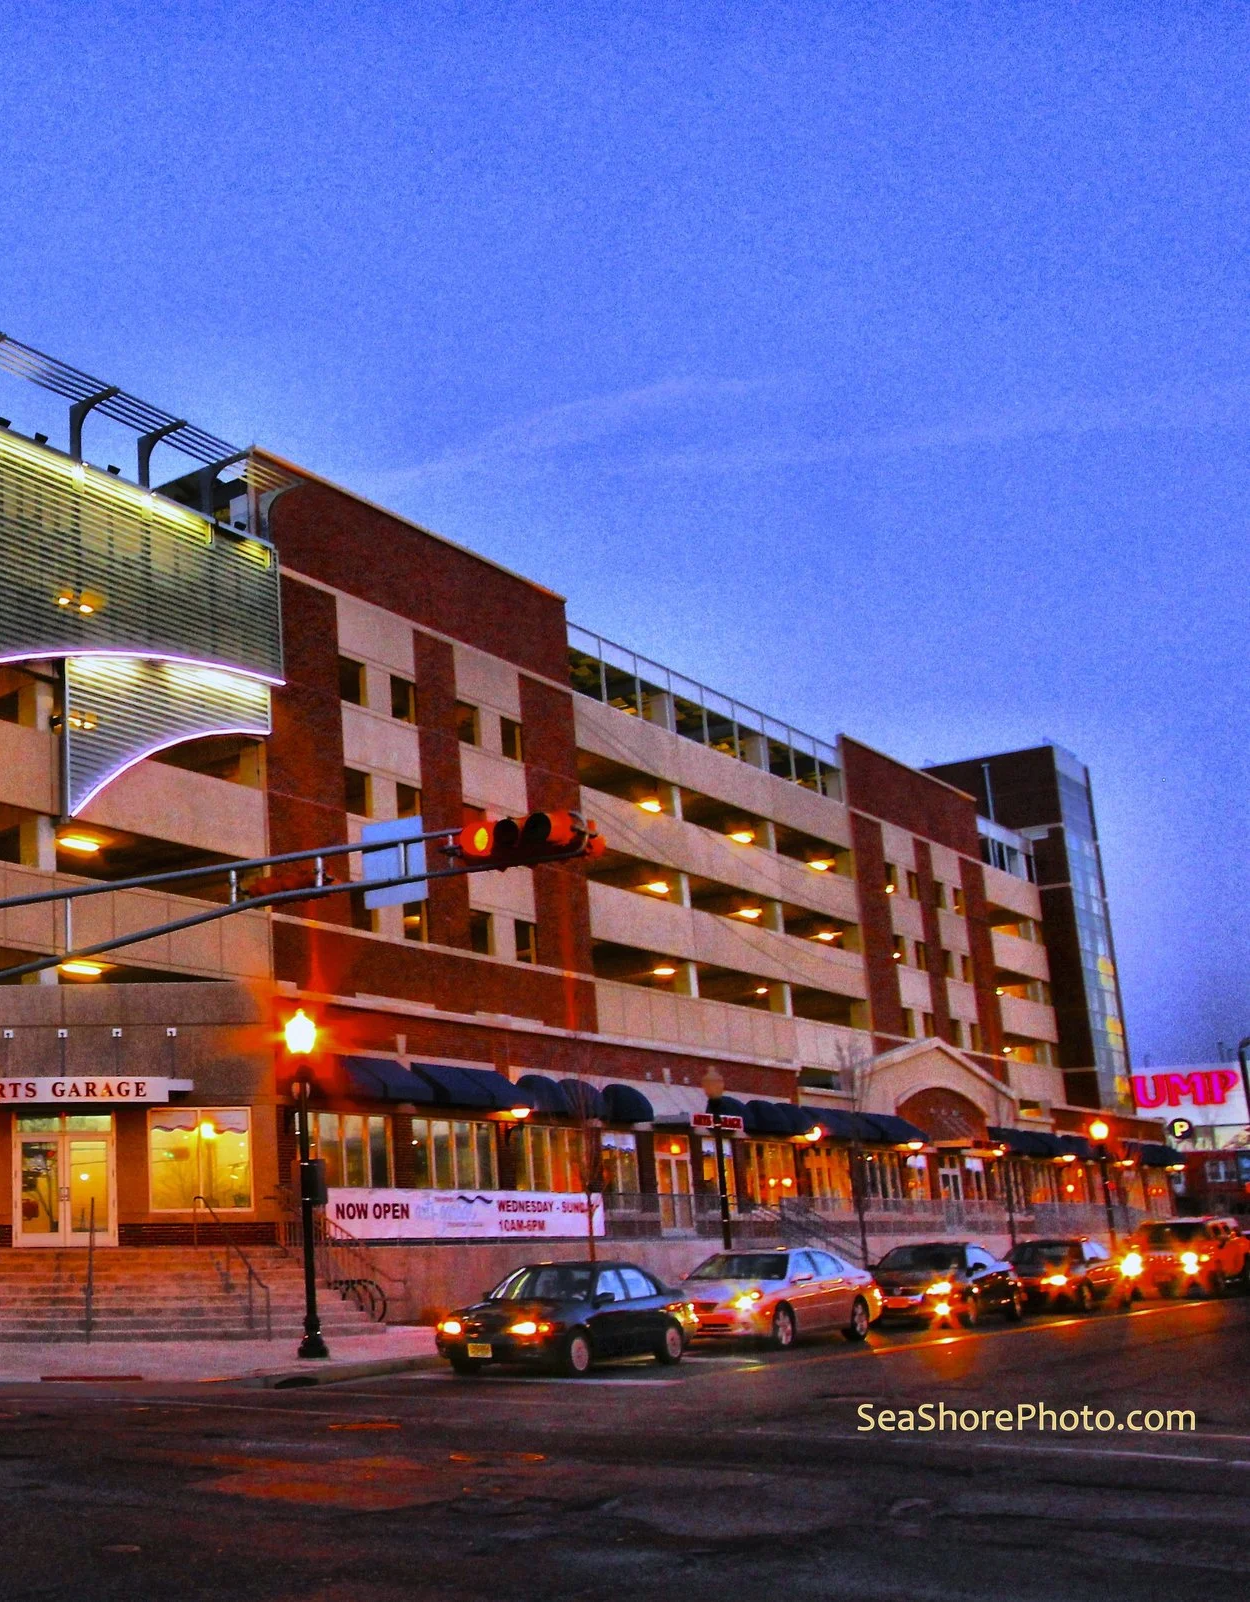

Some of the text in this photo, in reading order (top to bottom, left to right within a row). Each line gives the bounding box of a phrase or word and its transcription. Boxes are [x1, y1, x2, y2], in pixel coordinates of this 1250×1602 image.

[51, 1081, 147, 1098] GARAGE
[1173, 1121, 1190, 1137] P
[335, 1203, 368, 1220] NOW
[372, 1203, 409, 1220] OPEN
[497, 1200, 554, 1213] WEDNESDAY
